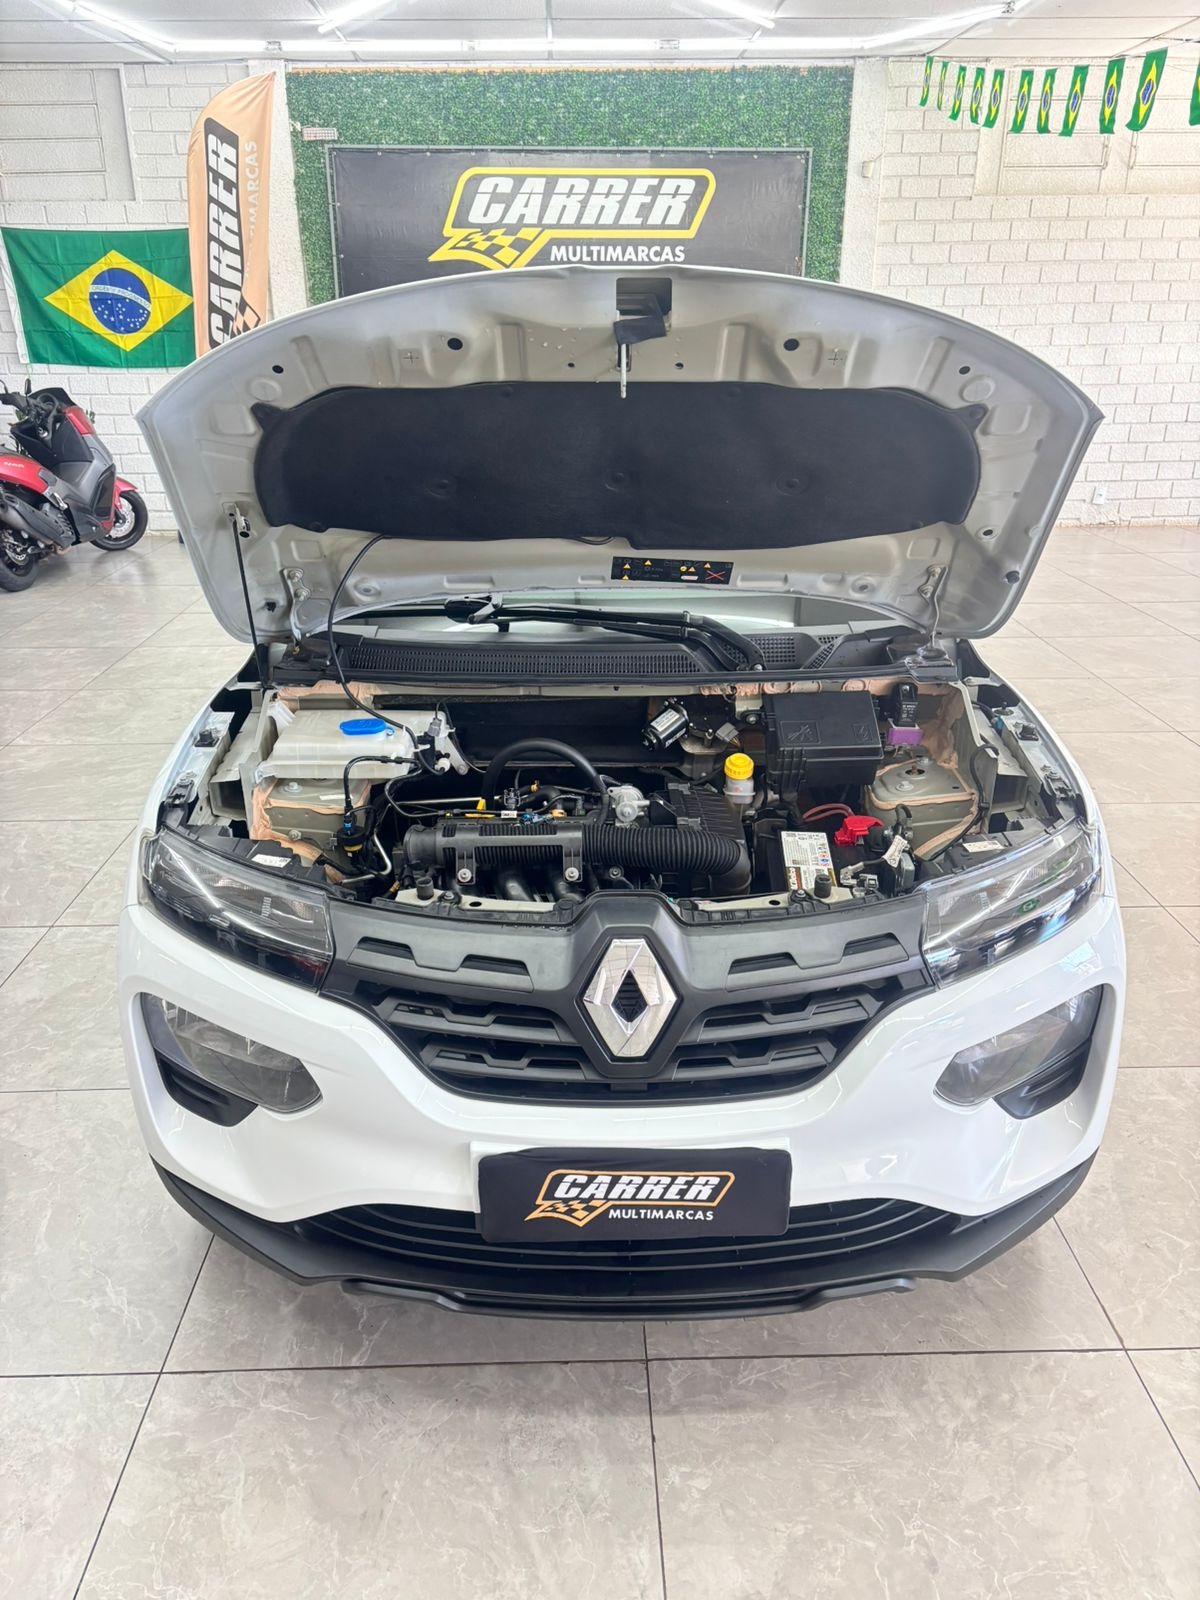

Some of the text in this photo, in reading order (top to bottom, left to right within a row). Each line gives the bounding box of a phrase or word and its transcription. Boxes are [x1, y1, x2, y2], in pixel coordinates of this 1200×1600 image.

[467, 176, 697, 225] CARRER
[207, 133, 243, 346] CARRER
[550, 245, 685, 262] MULTIMARCAS
[553, 1174, 721, 1200] CARRER
[608, 1208, 714, 1221] MULTIMARCAS
